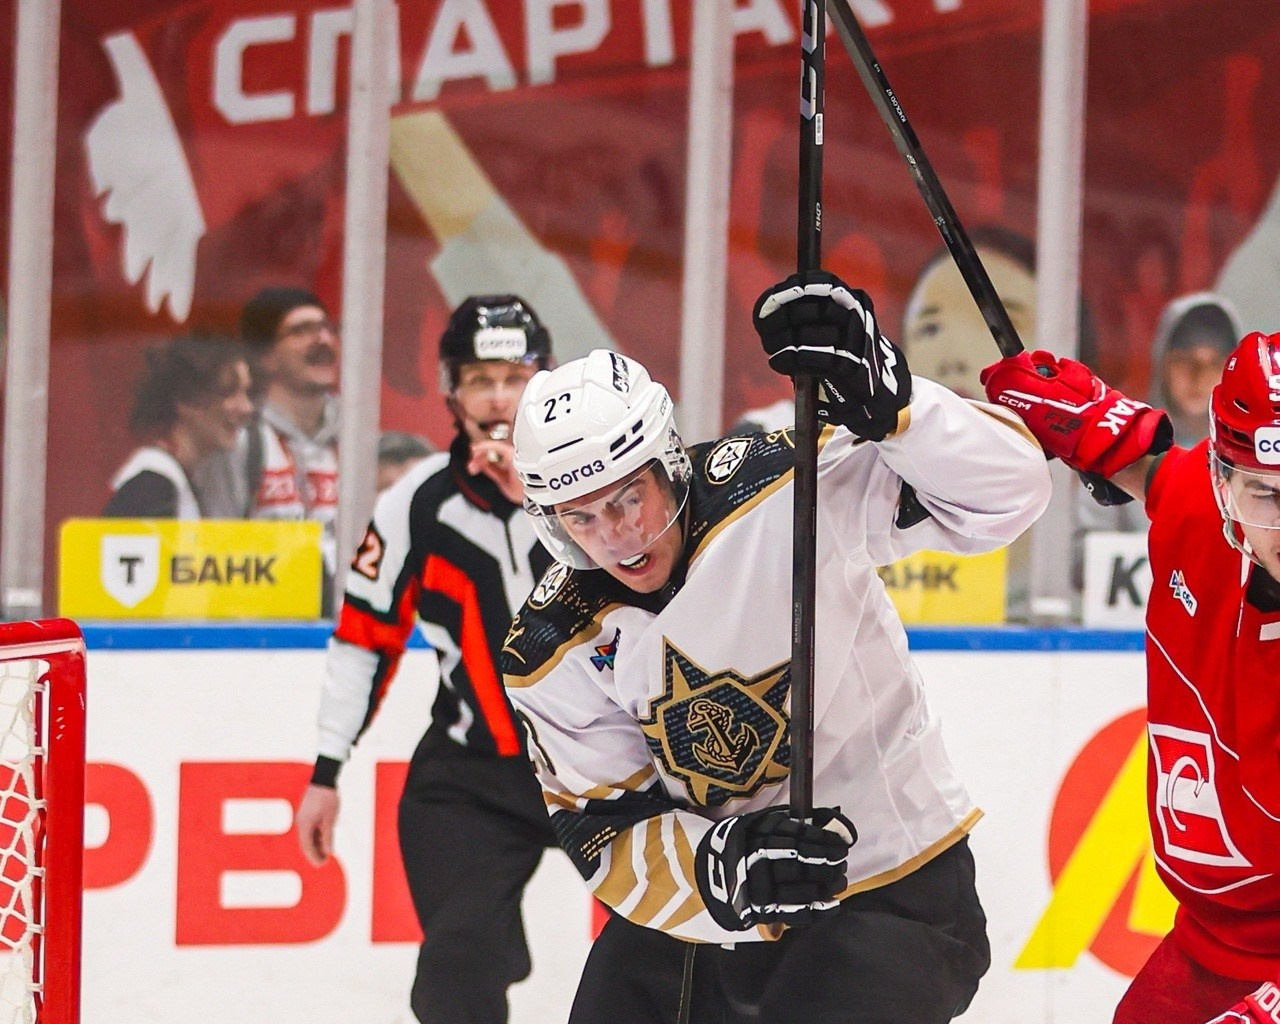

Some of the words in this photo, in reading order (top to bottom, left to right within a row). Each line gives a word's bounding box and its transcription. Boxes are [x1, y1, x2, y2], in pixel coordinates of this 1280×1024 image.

[998, 394, 1032, 412] CCM
[549, 460, 606, 491] согаз
[119, 556, 143, 584] Т
[170, 554, 277, 585] БАНК
